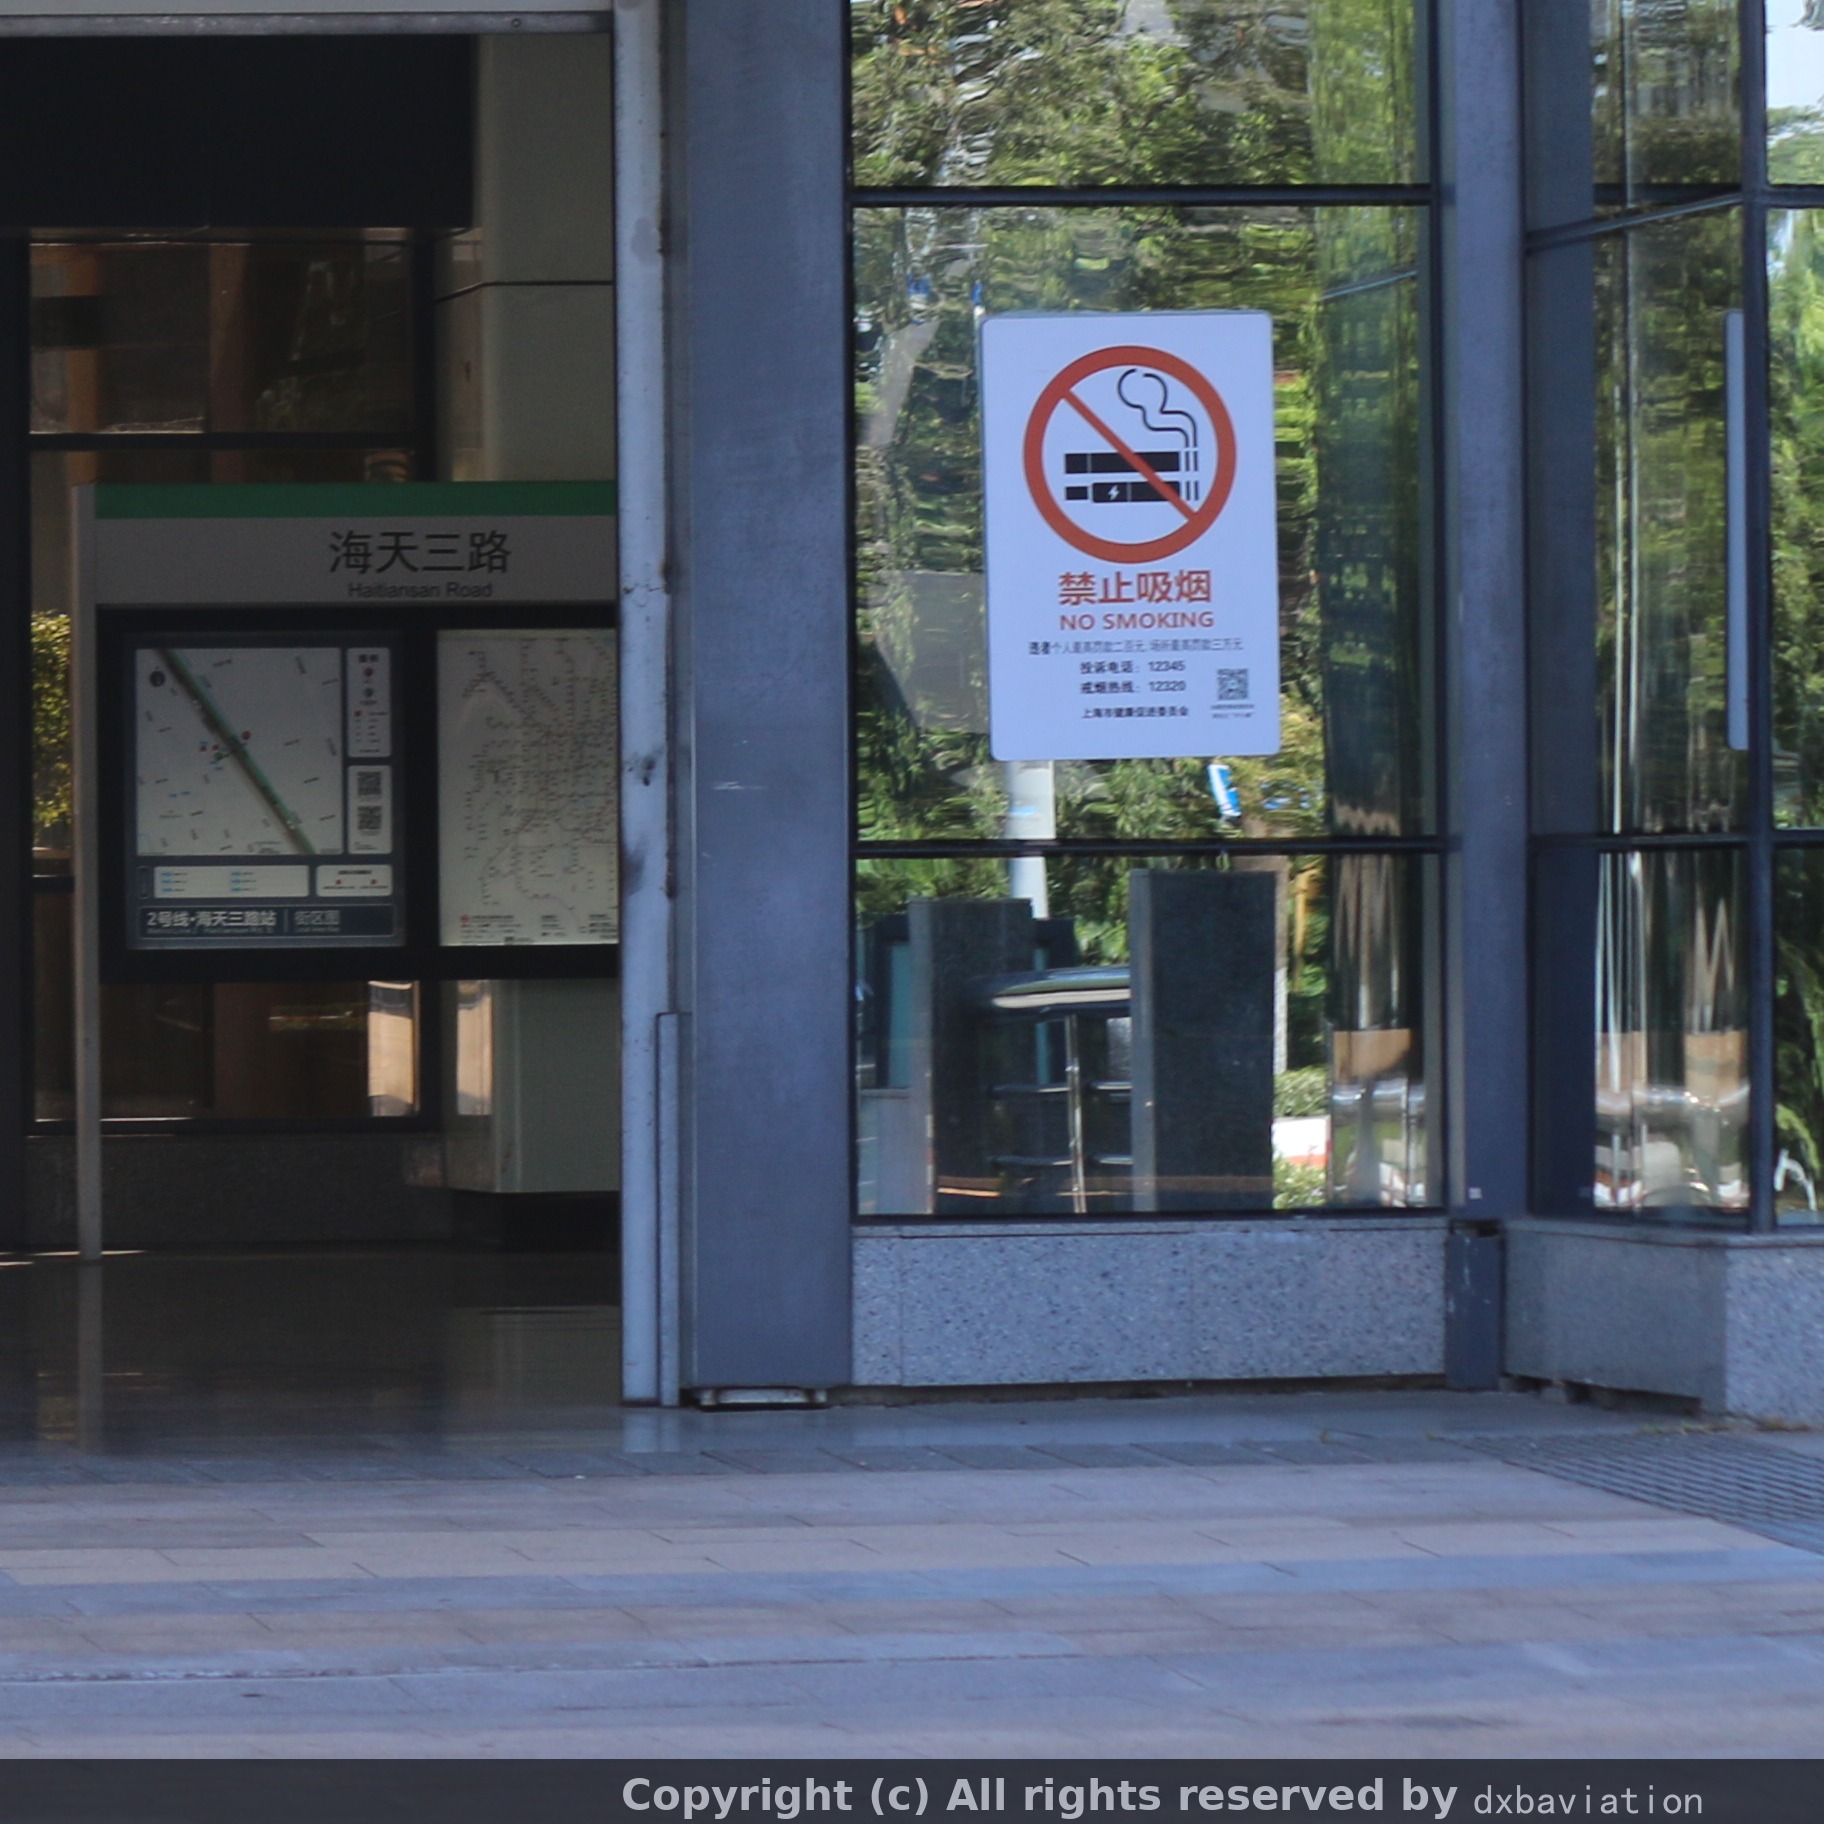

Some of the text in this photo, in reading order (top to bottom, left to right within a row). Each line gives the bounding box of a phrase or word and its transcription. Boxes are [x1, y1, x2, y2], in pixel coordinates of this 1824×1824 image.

[328, 529, 512, 575] 海天三路
[348, 581, 493, 598] Haitiansan Road
[1058, 570, 1212, 606] 禁止吸烟
[1059, 611, 1215, 631] NO SMOKING
[1147, 659, 1186, 673] 12345
[1147, 680, 1187, 693] 12320
